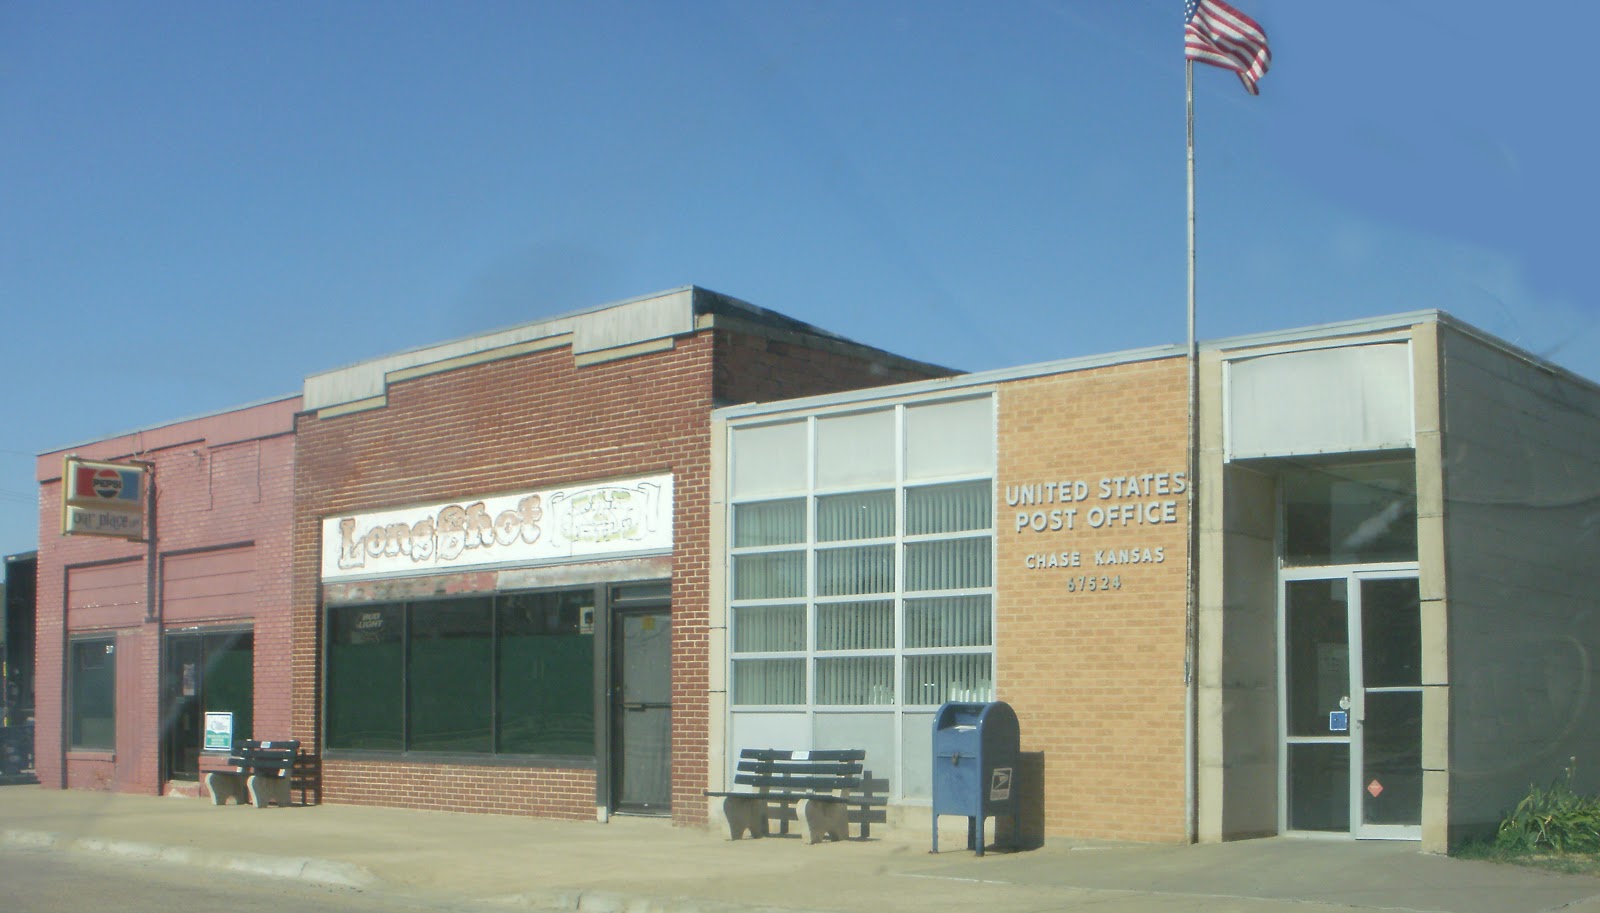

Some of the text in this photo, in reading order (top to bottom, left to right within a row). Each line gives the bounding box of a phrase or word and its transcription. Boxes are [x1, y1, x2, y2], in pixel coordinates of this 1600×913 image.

[1006, 472, 1187, 506] UNITED STATES
[1016, 500, 1177, 533] POST OFFICE
[1025, 547, 1165, 569] CHASE KANSAS
[1067, 575, 1122, 593] 67524
[357, 619, 384, 629] LIGHT
